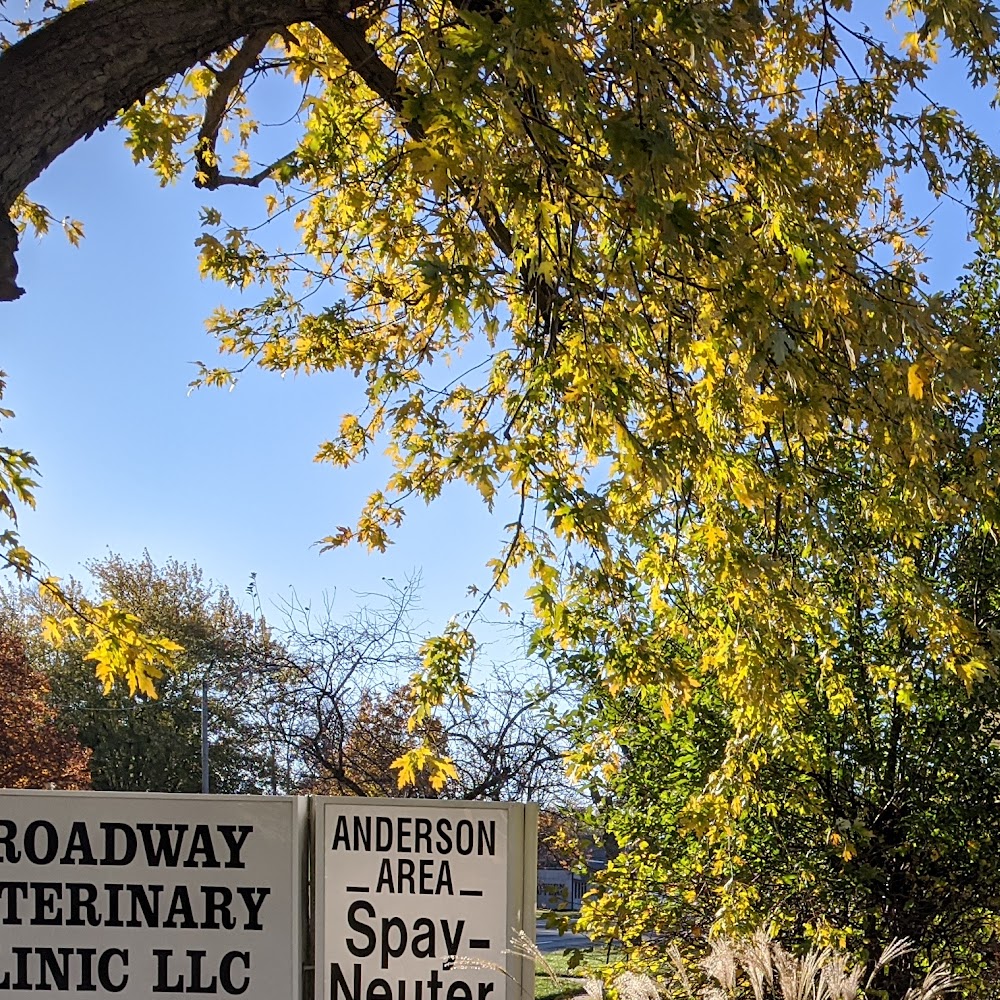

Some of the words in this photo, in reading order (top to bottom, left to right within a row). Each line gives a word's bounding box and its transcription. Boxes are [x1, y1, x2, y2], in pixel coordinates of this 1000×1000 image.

[331, 815, 496, 856] ANDERSON
[375, 858, 454, 896] AREA
[0, 881, 271, 931] TERINARY
[345, 900, 490, 971] Spay-
[152, 948, 251, 996] LLC
